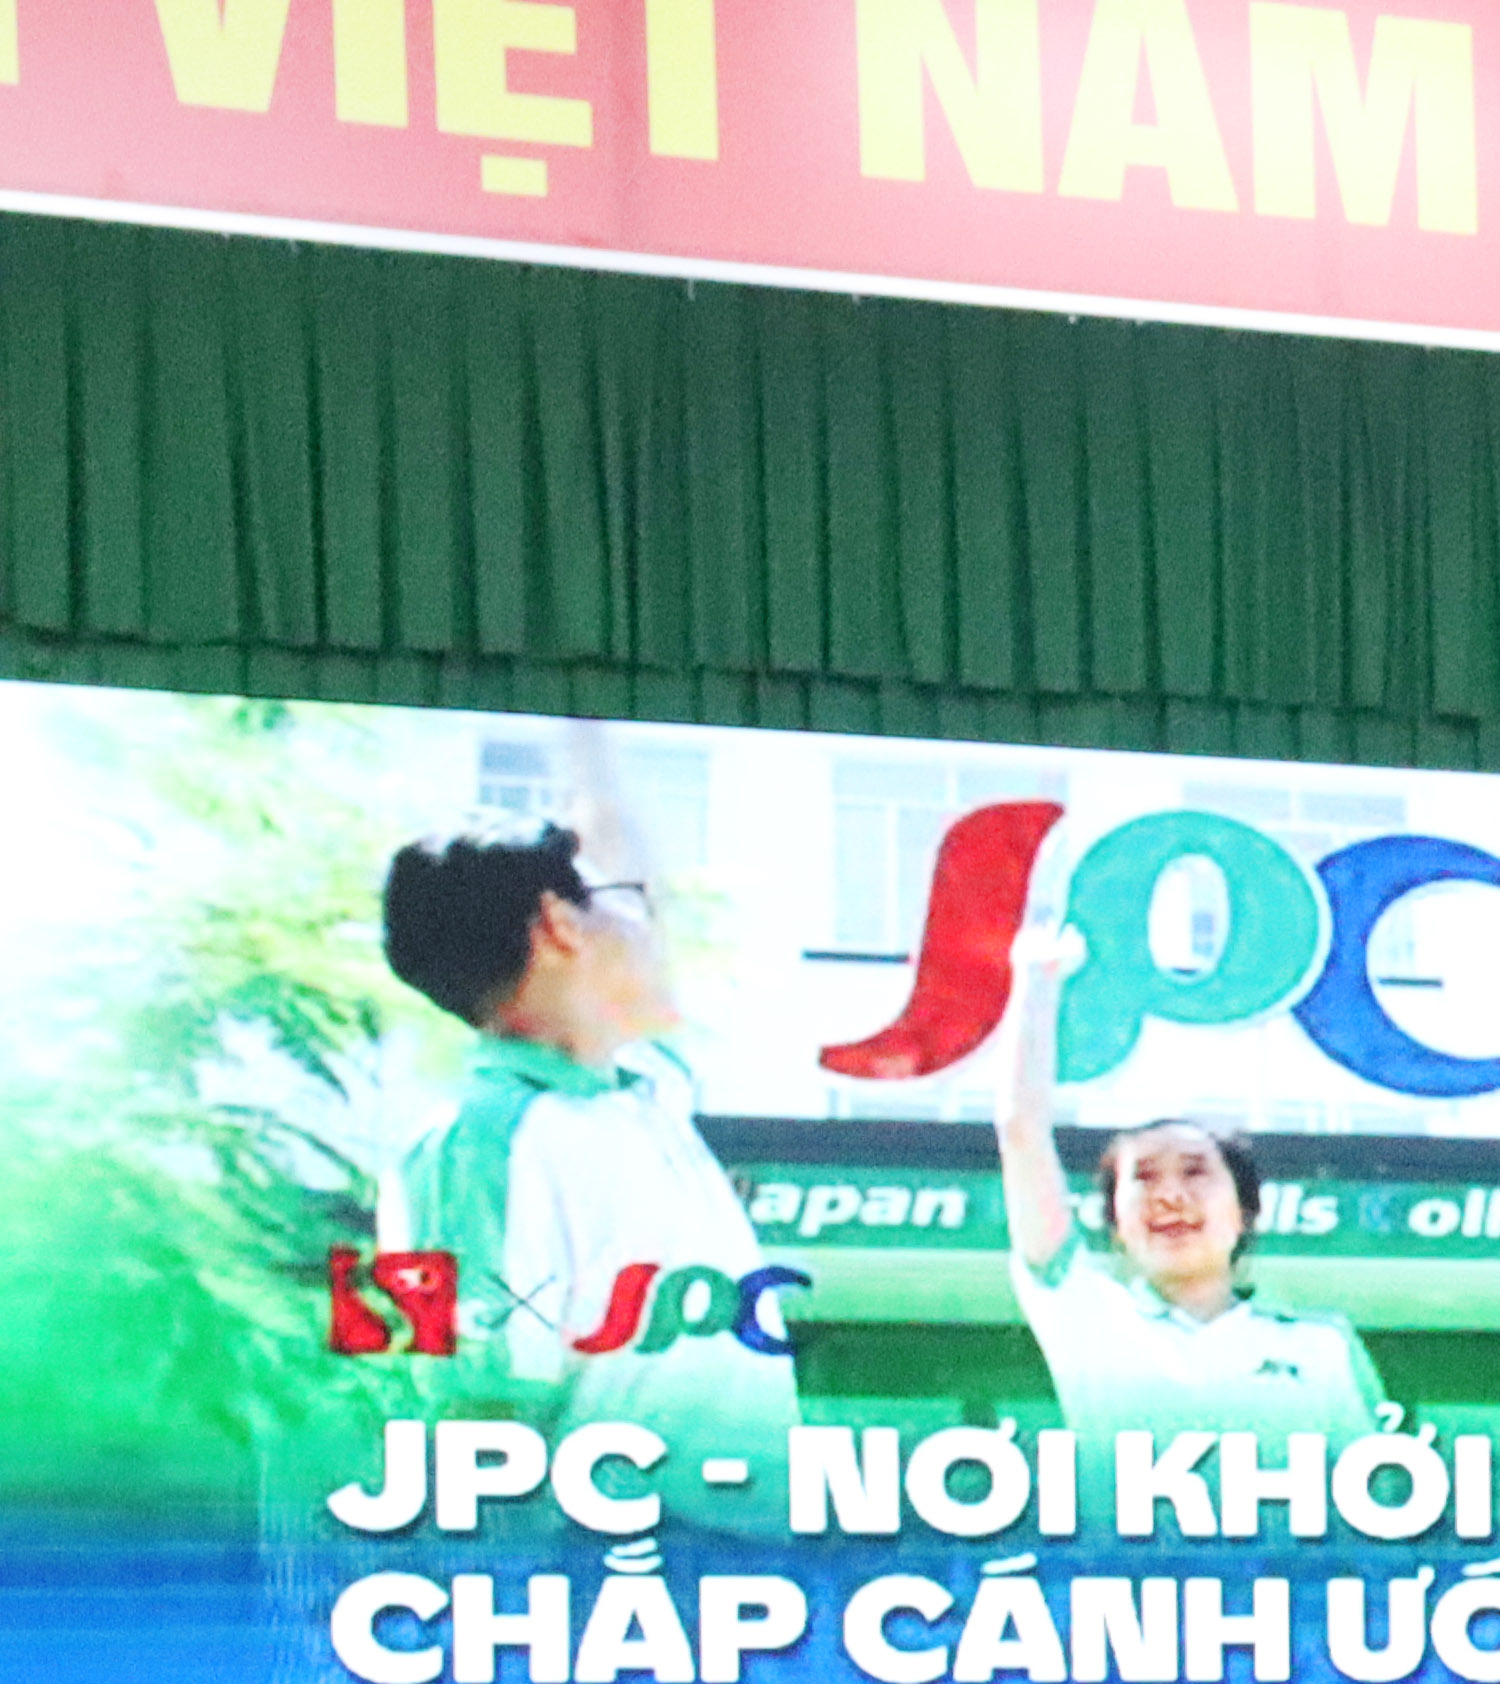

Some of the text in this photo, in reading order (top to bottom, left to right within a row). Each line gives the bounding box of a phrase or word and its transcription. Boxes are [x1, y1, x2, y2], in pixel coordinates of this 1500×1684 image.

[855, 0, 1480, 238] NAM
[572, 1262, 812, 1355] JPC
[327, 1419, 668, 1534] JPC
[788, 1416, 1077, 1537] NƠI
[1114, 1401, 1493, 1540] KHỞI
